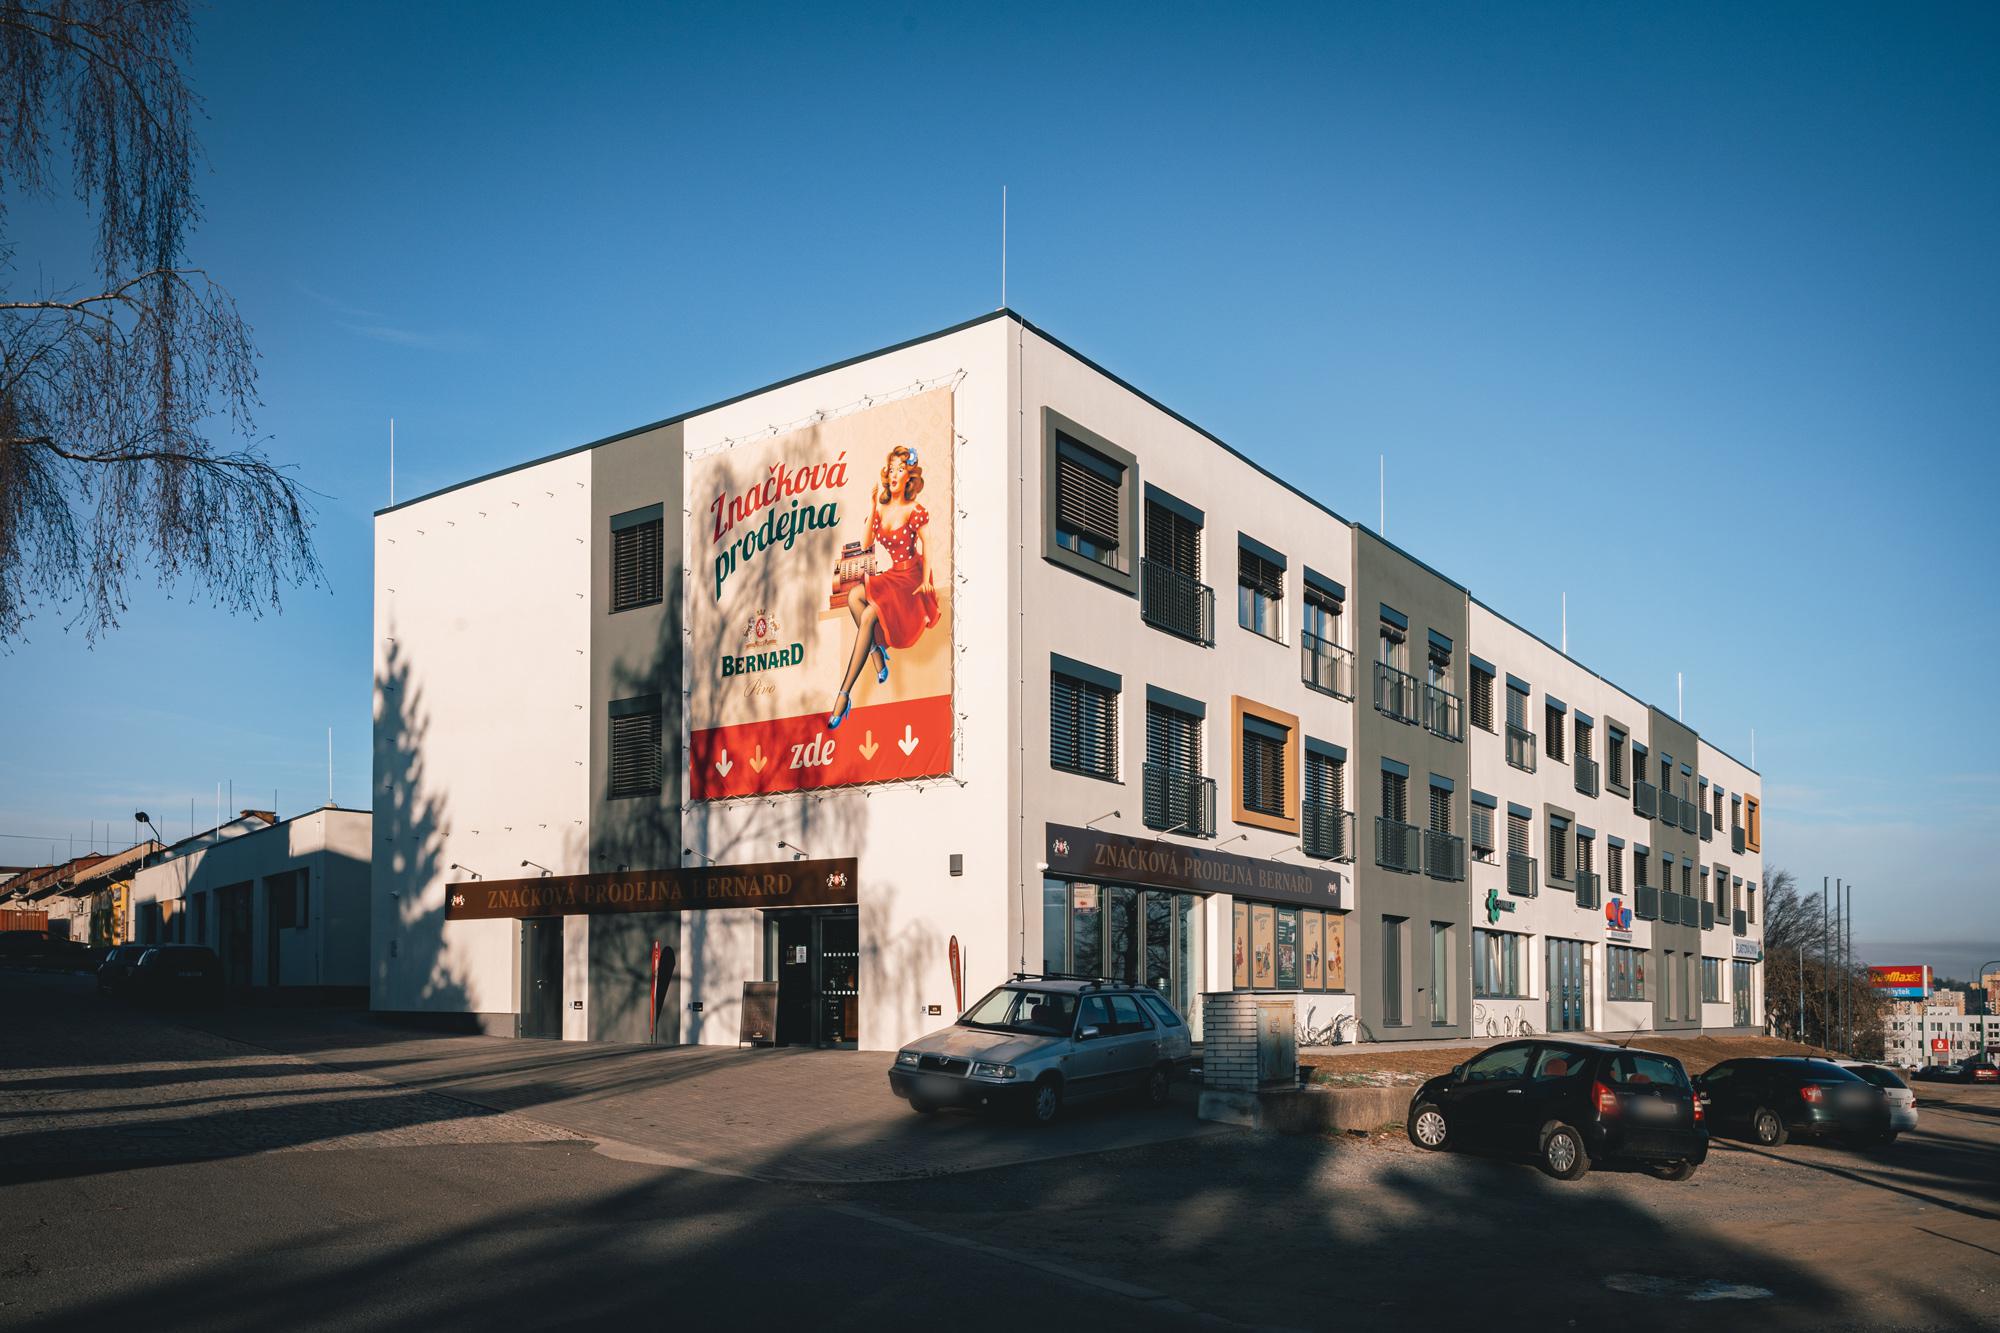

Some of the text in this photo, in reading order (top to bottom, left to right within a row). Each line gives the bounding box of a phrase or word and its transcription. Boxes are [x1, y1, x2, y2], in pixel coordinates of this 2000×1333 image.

[710, 451, 849, 544] Značková
[715, 499, 841, 603] prodejna
[721, 642, 804, 677] BERNARD
[744, 679, 776, 697] Pivo
[788, 732, 837, 770] zde
[1094, 843, 1313, 894] ZNAČKOVÁ PRODEJNA BERNARD
[487, 882, 576, 909] ZNAČKOVÁ
[584, 880, 683, 904] PRODEJNA
